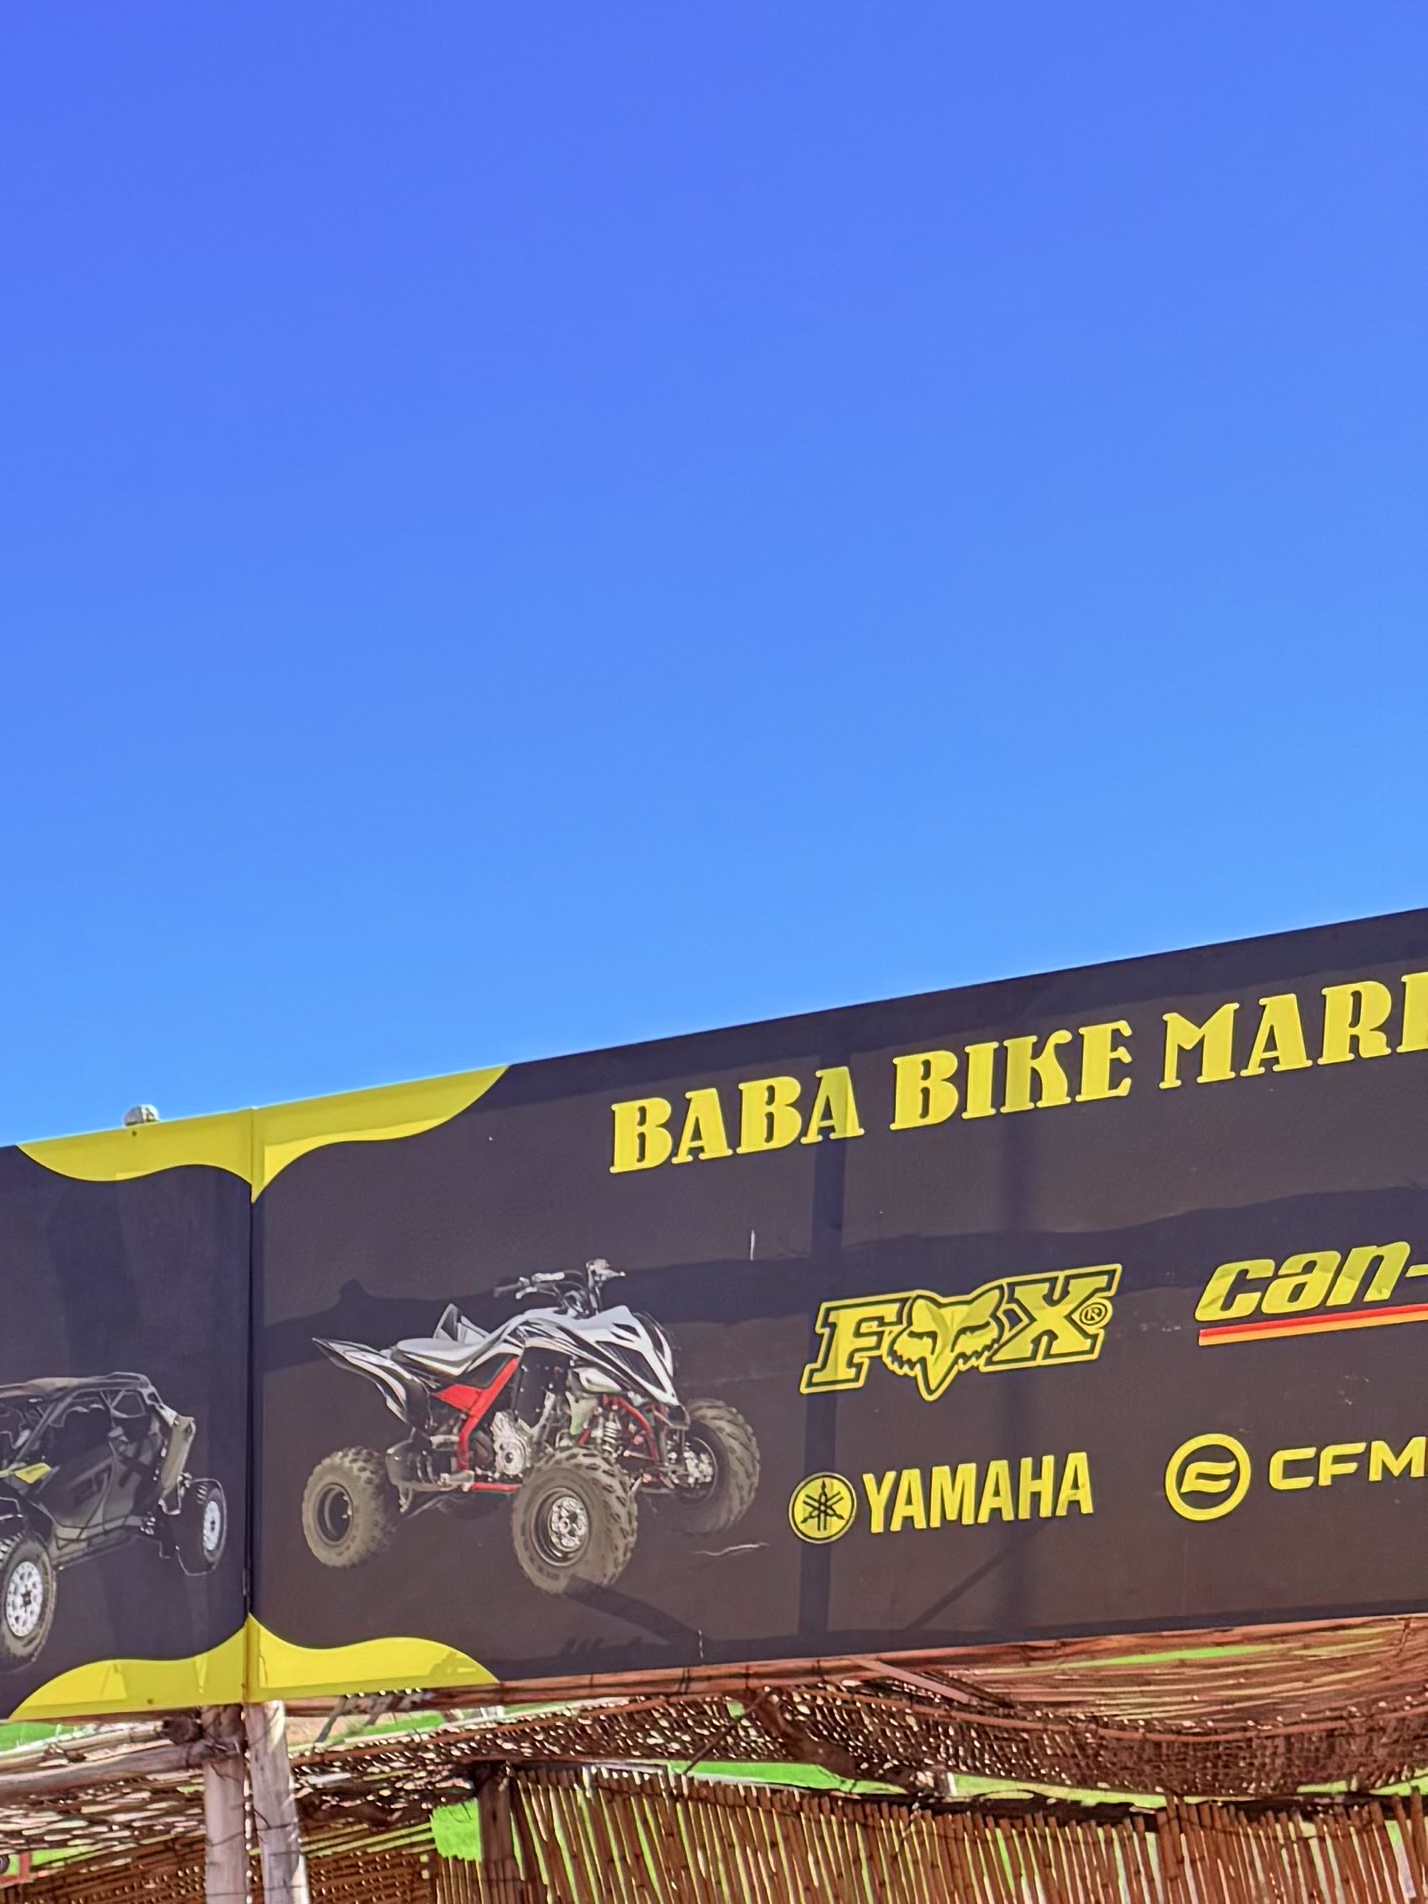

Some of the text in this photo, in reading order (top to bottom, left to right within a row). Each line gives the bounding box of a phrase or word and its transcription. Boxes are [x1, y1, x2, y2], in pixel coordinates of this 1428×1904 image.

[610, 1066, 864, 1174] BABA
[889, 1020, 1133, 1131] BIKE
[862, 1450, 1095, 1535] YAMAHA
[1268, 1436, 1427, 1491] CFM
